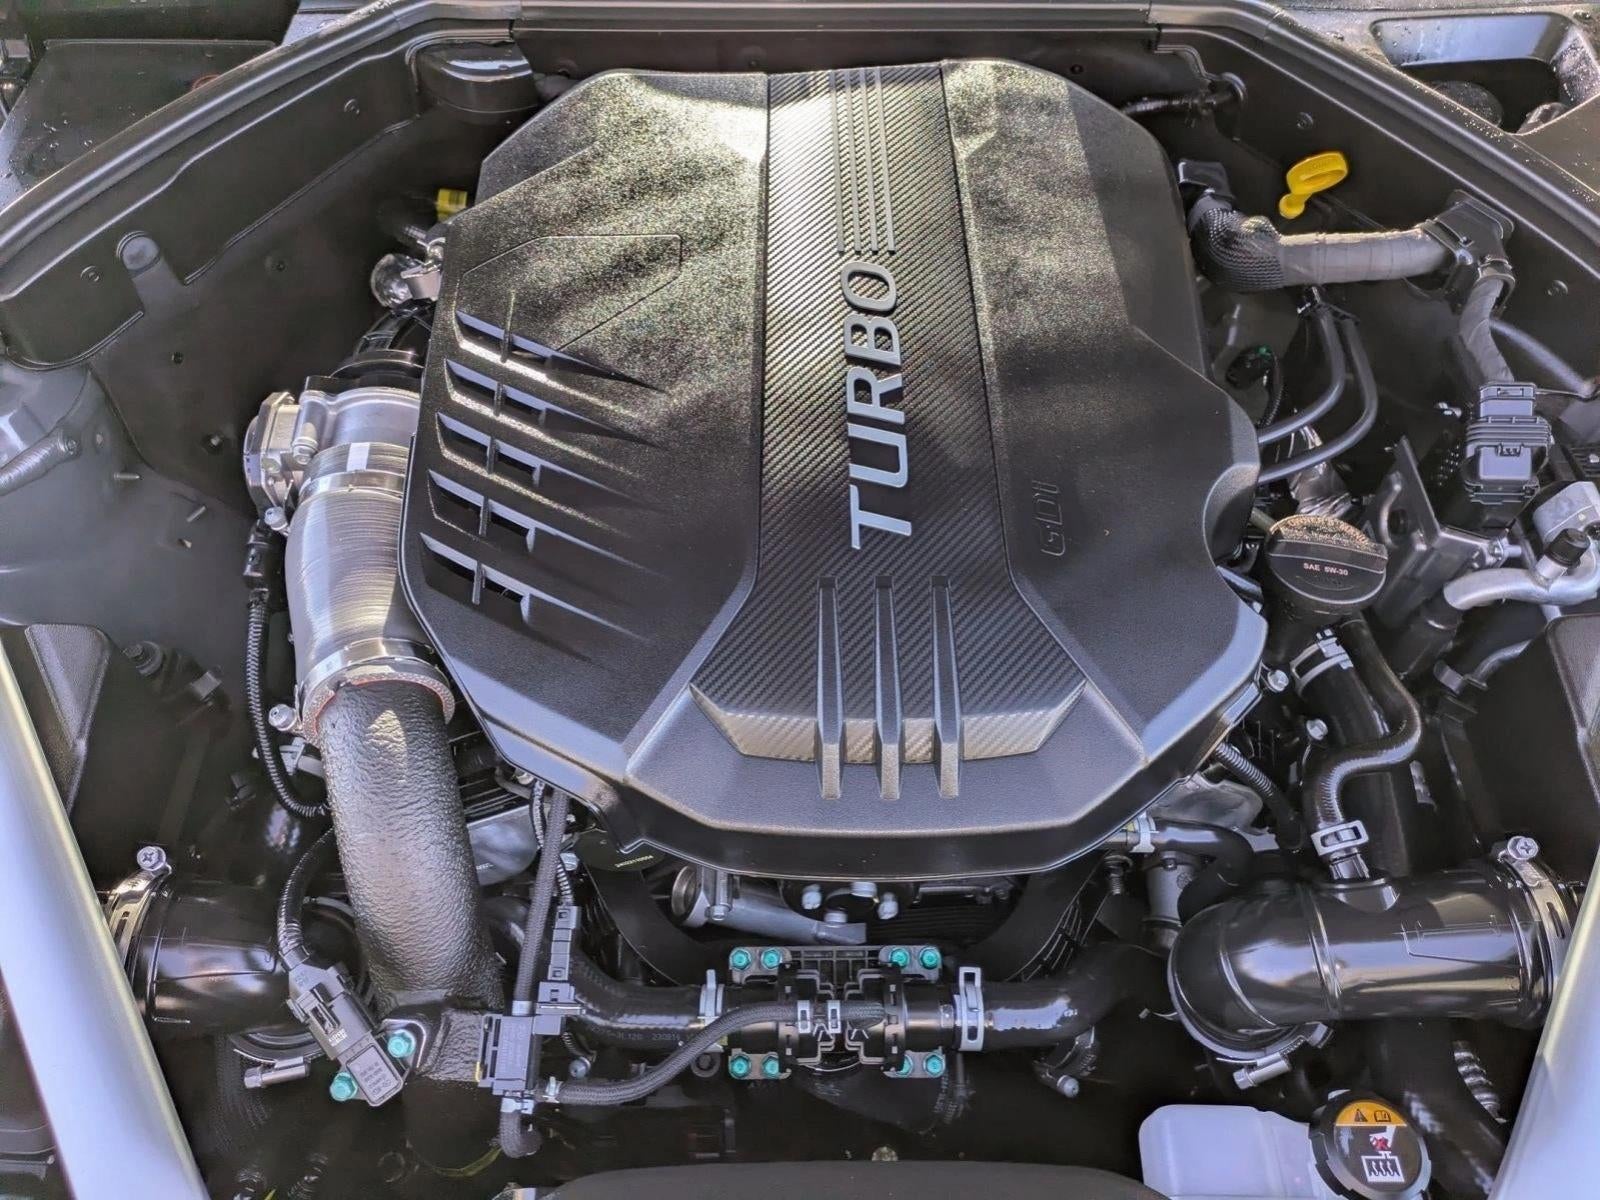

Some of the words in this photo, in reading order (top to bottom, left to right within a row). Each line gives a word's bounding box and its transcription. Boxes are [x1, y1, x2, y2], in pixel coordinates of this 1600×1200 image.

[841, 261, 912, 549] TURBO
[1032, 480, 1065, 556] GDI
[1303, 562, 1321, 572] SAE
[1324, 565, 1349, 576] 5W-30
